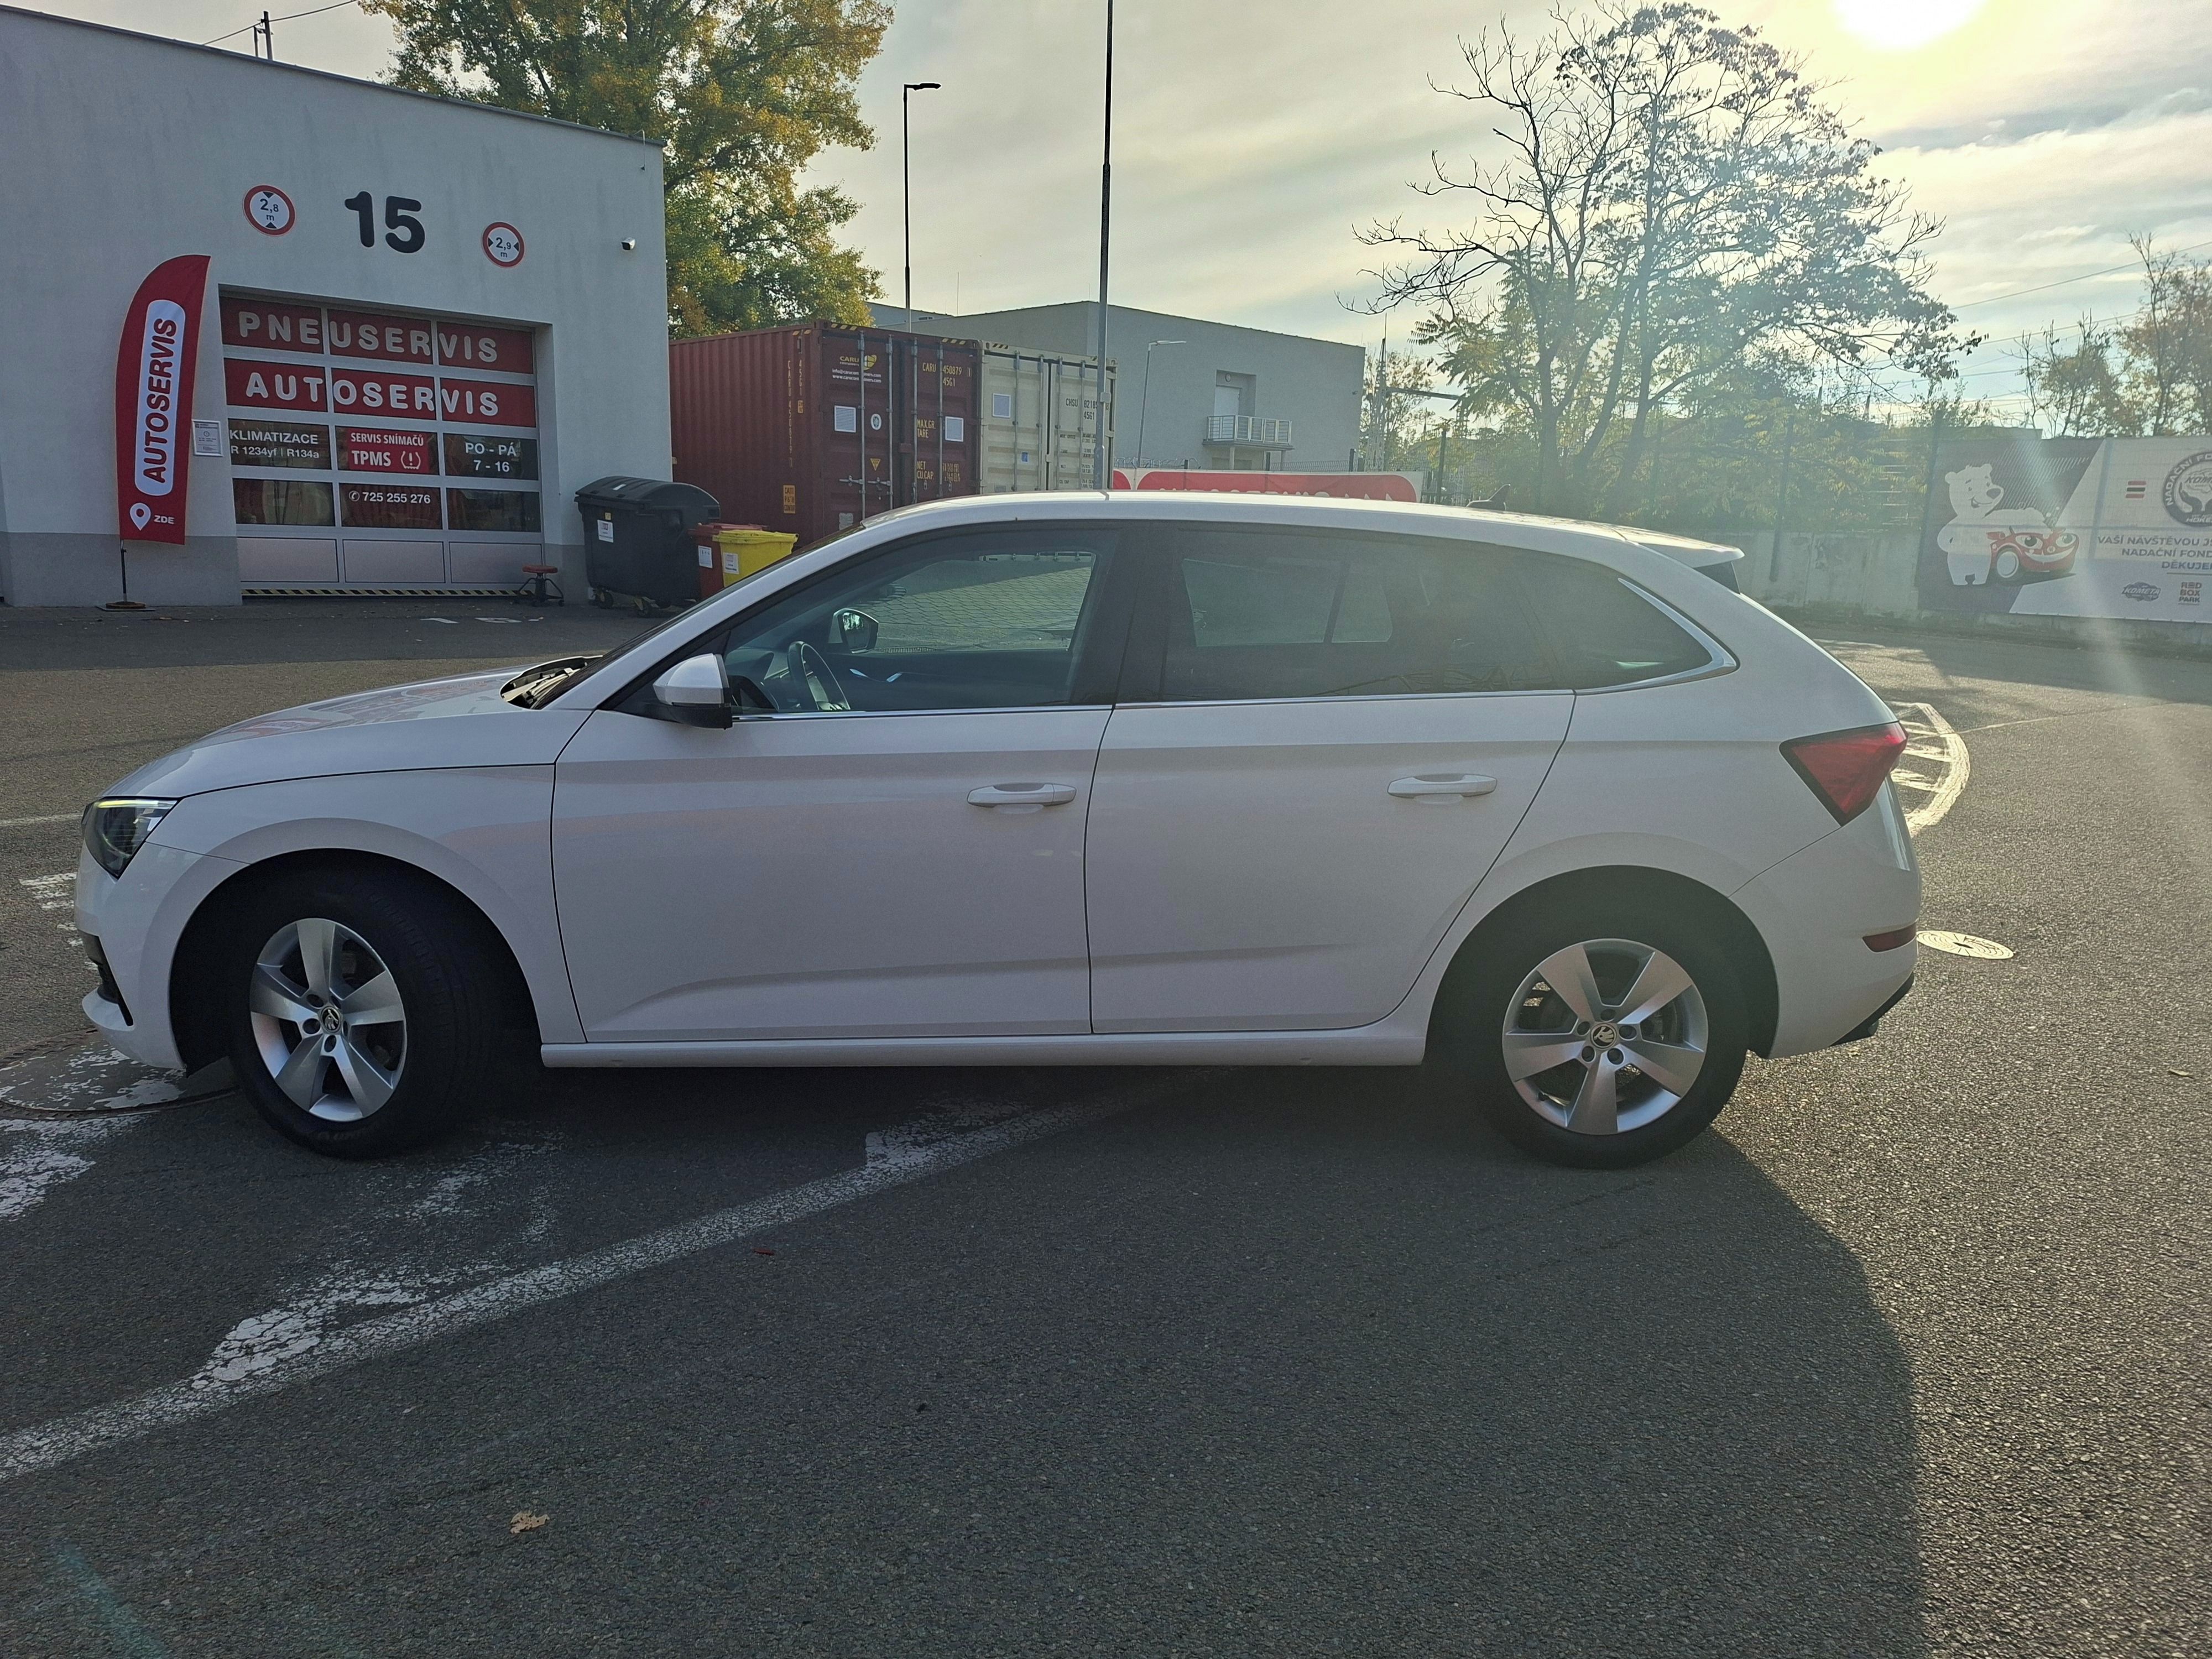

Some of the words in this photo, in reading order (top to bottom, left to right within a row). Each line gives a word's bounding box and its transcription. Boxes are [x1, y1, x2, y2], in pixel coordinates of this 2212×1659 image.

[260, 198, 279, 213] 2,8
[345, 191, 425, 254] 15
[495, 237, 512, 251] 2,9
[239, 311, 497, 362] PNEUSERVIS
[922, 362, 936, 372] CARU
[943, 365, 962, 375] 450879
[943, 377, 956, 387] 45G1
[143, 318, 177, 483] AUTOSERVIS
[246, 372, 498, 416] AUTOSERVIS
[1066, 398, 1078, 407] CHSU
[1084, 400, 1097, 409] 8218
[229, 430, 319, 444] KLIMATIZACE
[351, 433, 381, 443] SERVIS
[384, 434, 424, 446] SNÍMAČŮ
[917, 428, 929, 438] TARE
[231, 446, 239, 455] R
[242, 446, 277, 457] 1234yf
[287, 449, 320, 458] R134a
[465, 443, 485, 454] PO
[498, 443, 517, 456] PÁ
[352, 450, 391, 466] TPMS
[473, 460, 481, 471] 7
[495, 462, 510, 472] 16
[362, 492, 383, 502] 725
[387, 493, 407, 503] 255
[410, 494, 431, 504] 276
[154, 515, 175, 524] ZDE
[2098, 535, 2124, 545] VAŠÍ
[2127, 535, 2199, 546] NÁVŠTĚVOU
[2121, 547, 2177, 557] NADAČNÍ
[2162, 560, 2212, 570] DĚKUJE
